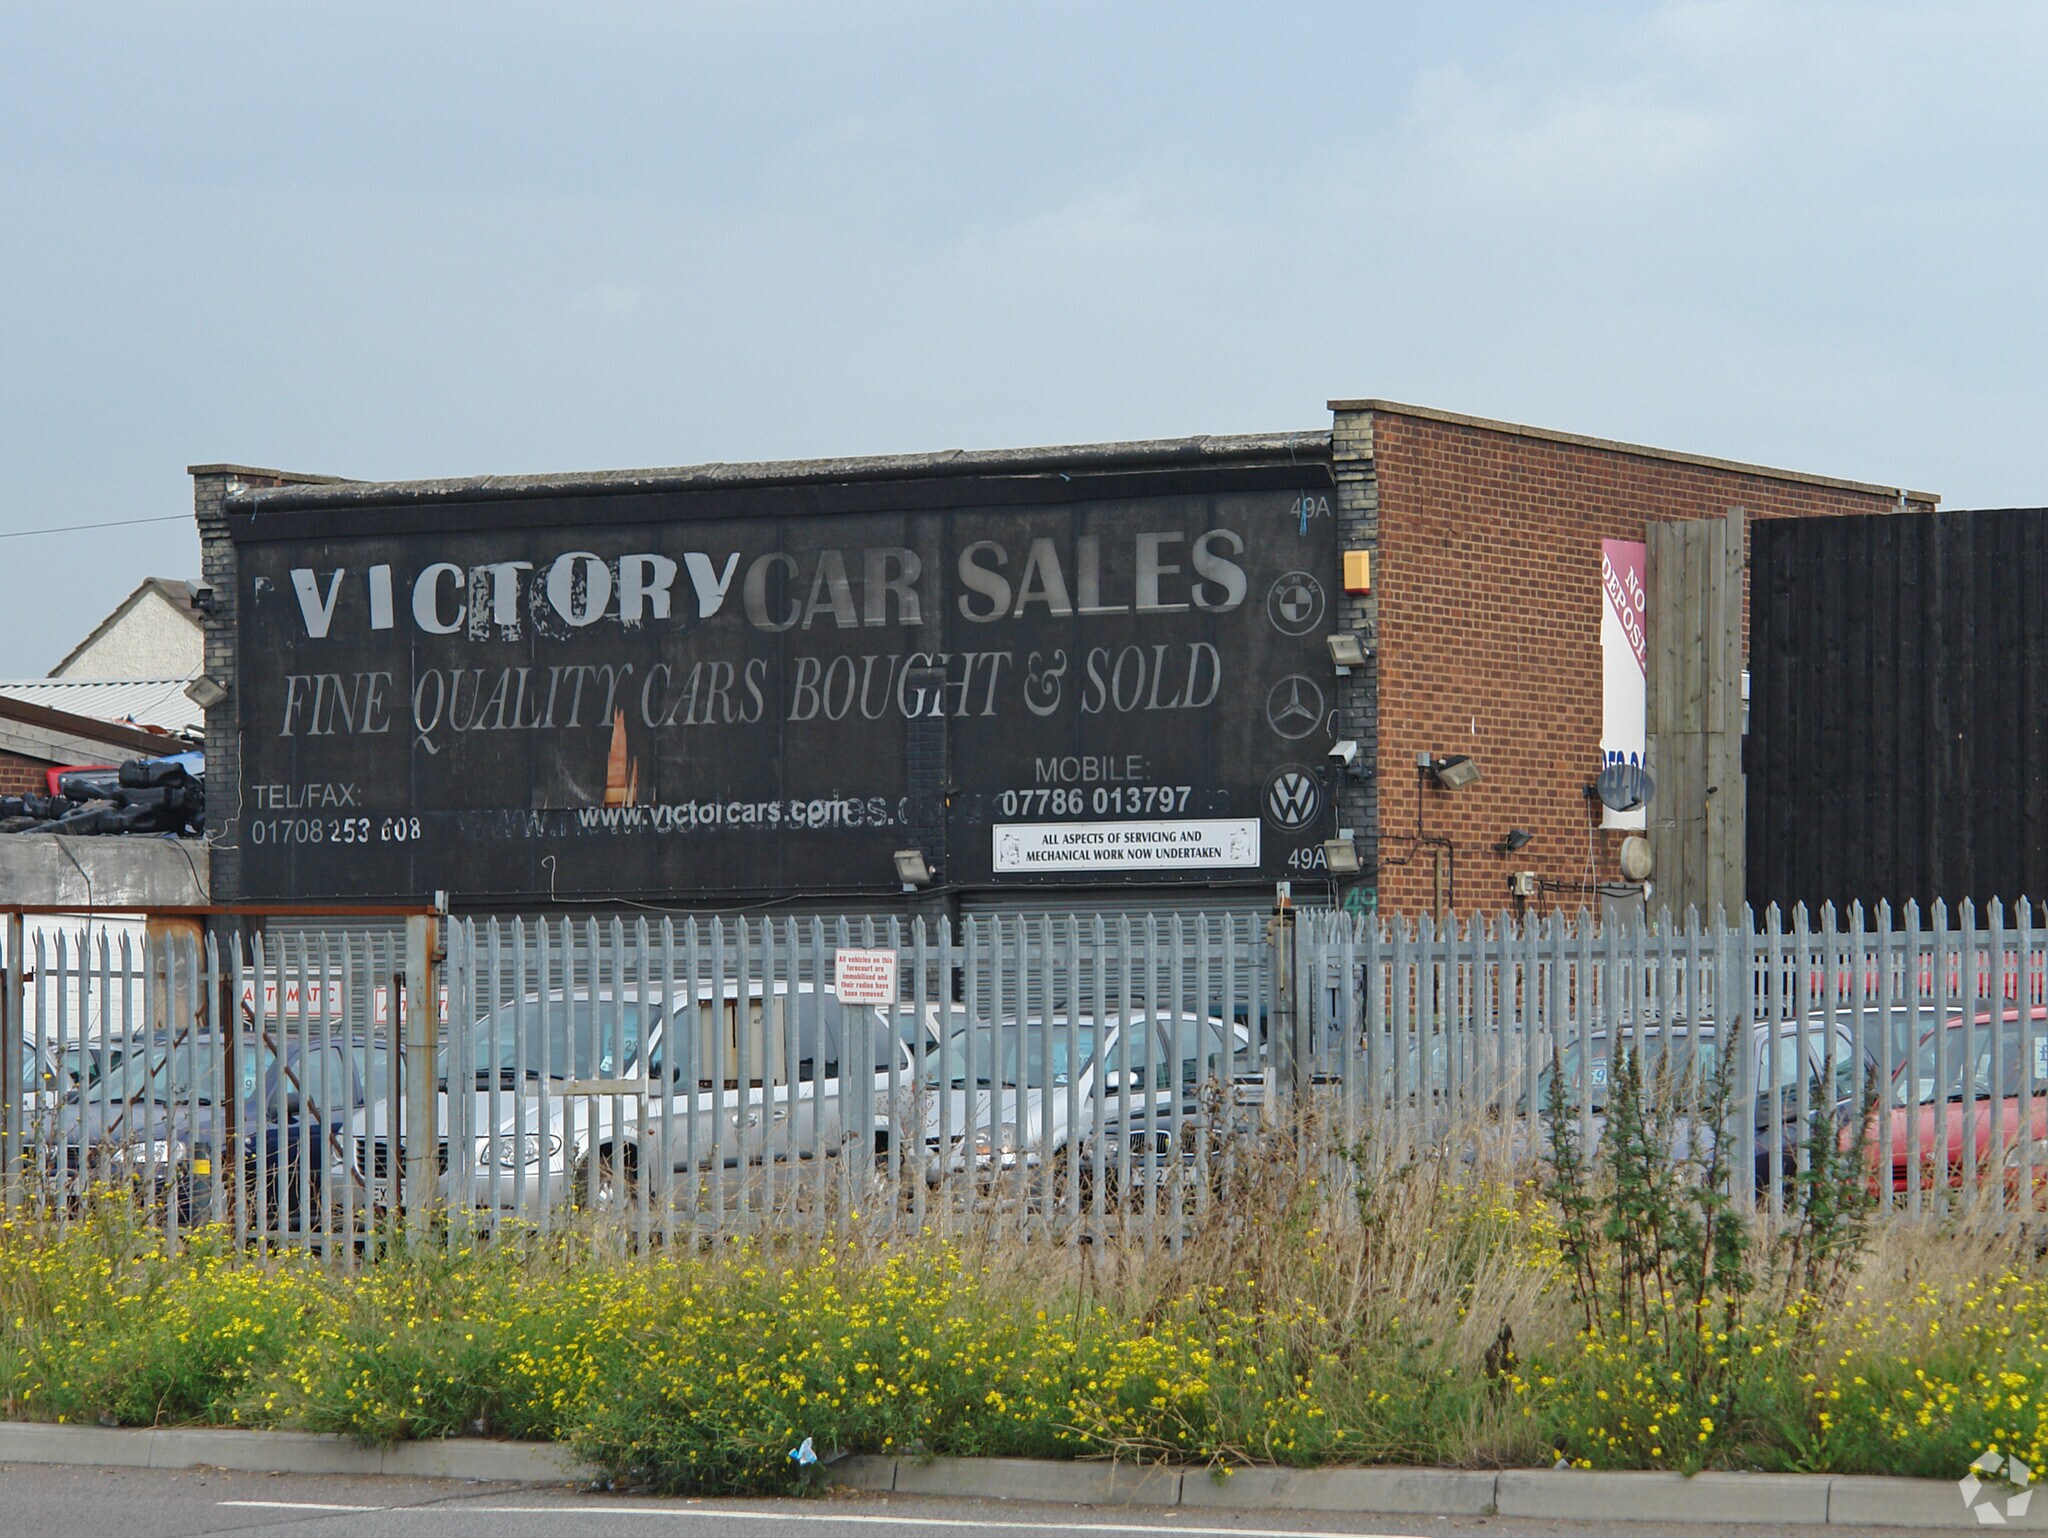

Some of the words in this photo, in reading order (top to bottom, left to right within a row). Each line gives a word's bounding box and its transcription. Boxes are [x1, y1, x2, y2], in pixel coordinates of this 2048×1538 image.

[1290, 496, 1331, 518] 49A
[290, 551, 741, 638] VICTORY
[743, 547, 924, 632] CAR
[958, 528, 1248, 623] SALES
[1275, 576, 1319, 595] BMW
[1625, 565, 1645, 613] NO
[1602, 552, 1646, 671] DEPOSI
[279, 671, 393, 737] FINE
[414, 663, 633, 755] QUALITY
[641, 658, 768, 728] CARS
[787, 651, 1013, 721] BOUGHT
[1023, 649, 1068, 717] &
[1080, 642, 1222, 714] SOLD
[1035, 755, 1151, 783] MOBILE:
[252, 783, 362, 809] TEL/FAX:
[1002, 788, 1084, 817] 07786
[1092, 786, 1192, 814] 013797
[252, 818, 323, 844] 01708
[328, 818, 371, 843] 253
[1042, 834, 1059, 845] ALL
[1062, 833, 1104, 844] ASPECTS
[1108, 832, 1121, 843] OF
[1124, 832, 1176, 844] SERVICING
[1180, 831, 1202, 842] AND
[1026, 850, 1091, 862] MECHANICAL
[1093, 849, 1124, 860] WORK
[1127, 849, 1152, 860] NOW
[1156, 847, 1222, 859] UNDERTAKEN
[1287, 848, 1328, 870] 49A
